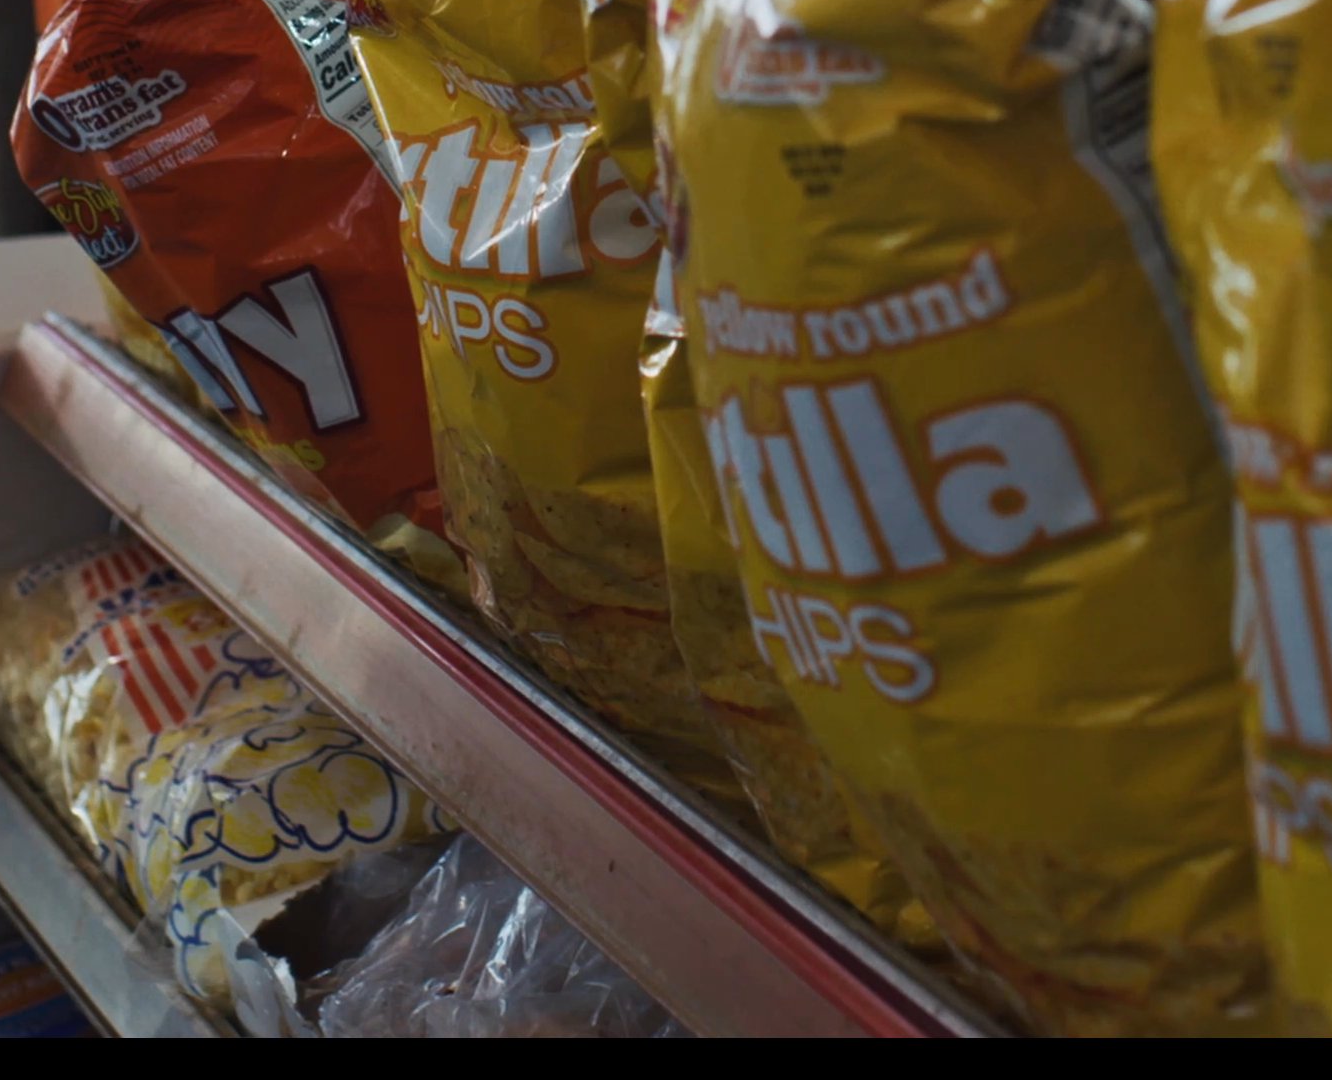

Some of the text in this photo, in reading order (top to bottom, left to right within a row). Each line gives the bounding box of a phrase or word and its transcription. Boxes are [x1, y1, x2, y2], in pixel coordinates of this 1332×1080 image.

[75, 95, 138, 134] trans
[136, 72, 182, 106] fat
[159, 155, 179, 174] FAT
[176, 132, 220, 166] CONTENT
[803, 247, 1011, 360] round
